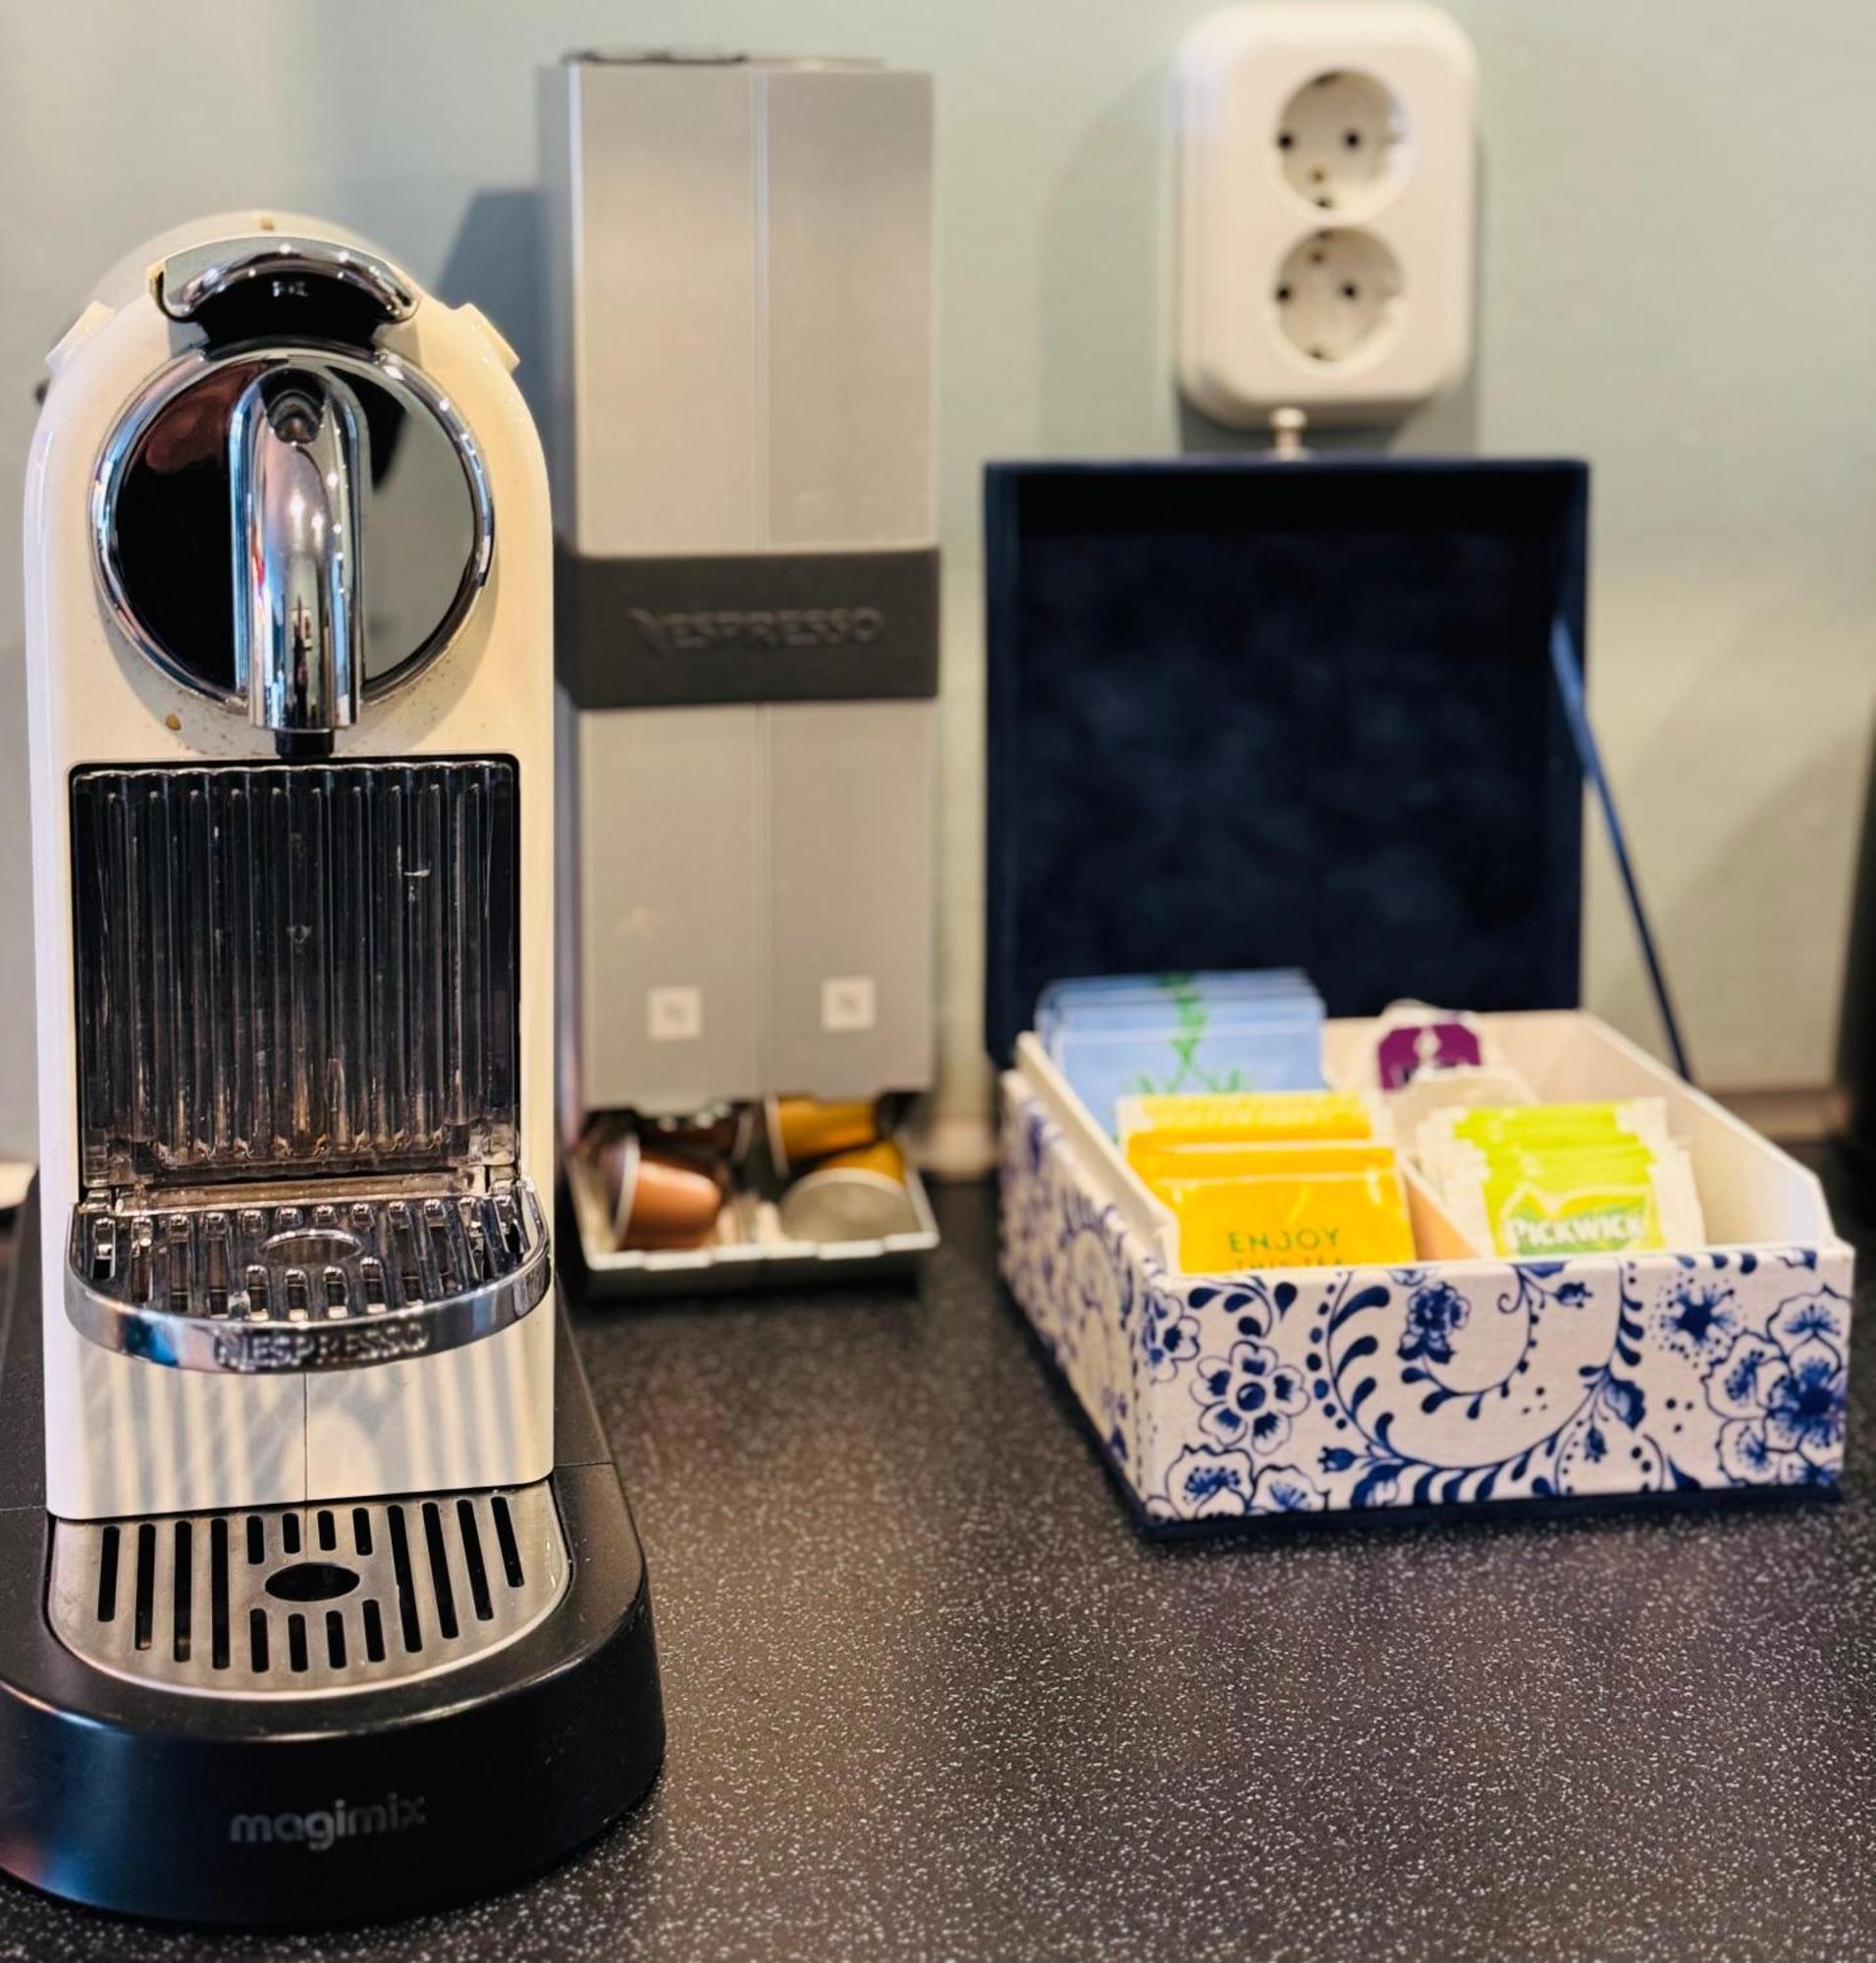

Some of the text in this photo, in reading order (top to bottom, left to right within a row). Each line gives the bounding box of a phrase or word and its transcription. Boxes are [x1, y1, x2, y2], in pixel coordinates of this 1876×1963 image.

[1228, 1227, 1340, 1253] ENJOY
[1505, 1210, 1645, 1250] PICKWICK
[214, 1323, 430, 1371] NESPRESSO
[230, 1791, 426, 1851] magimix
